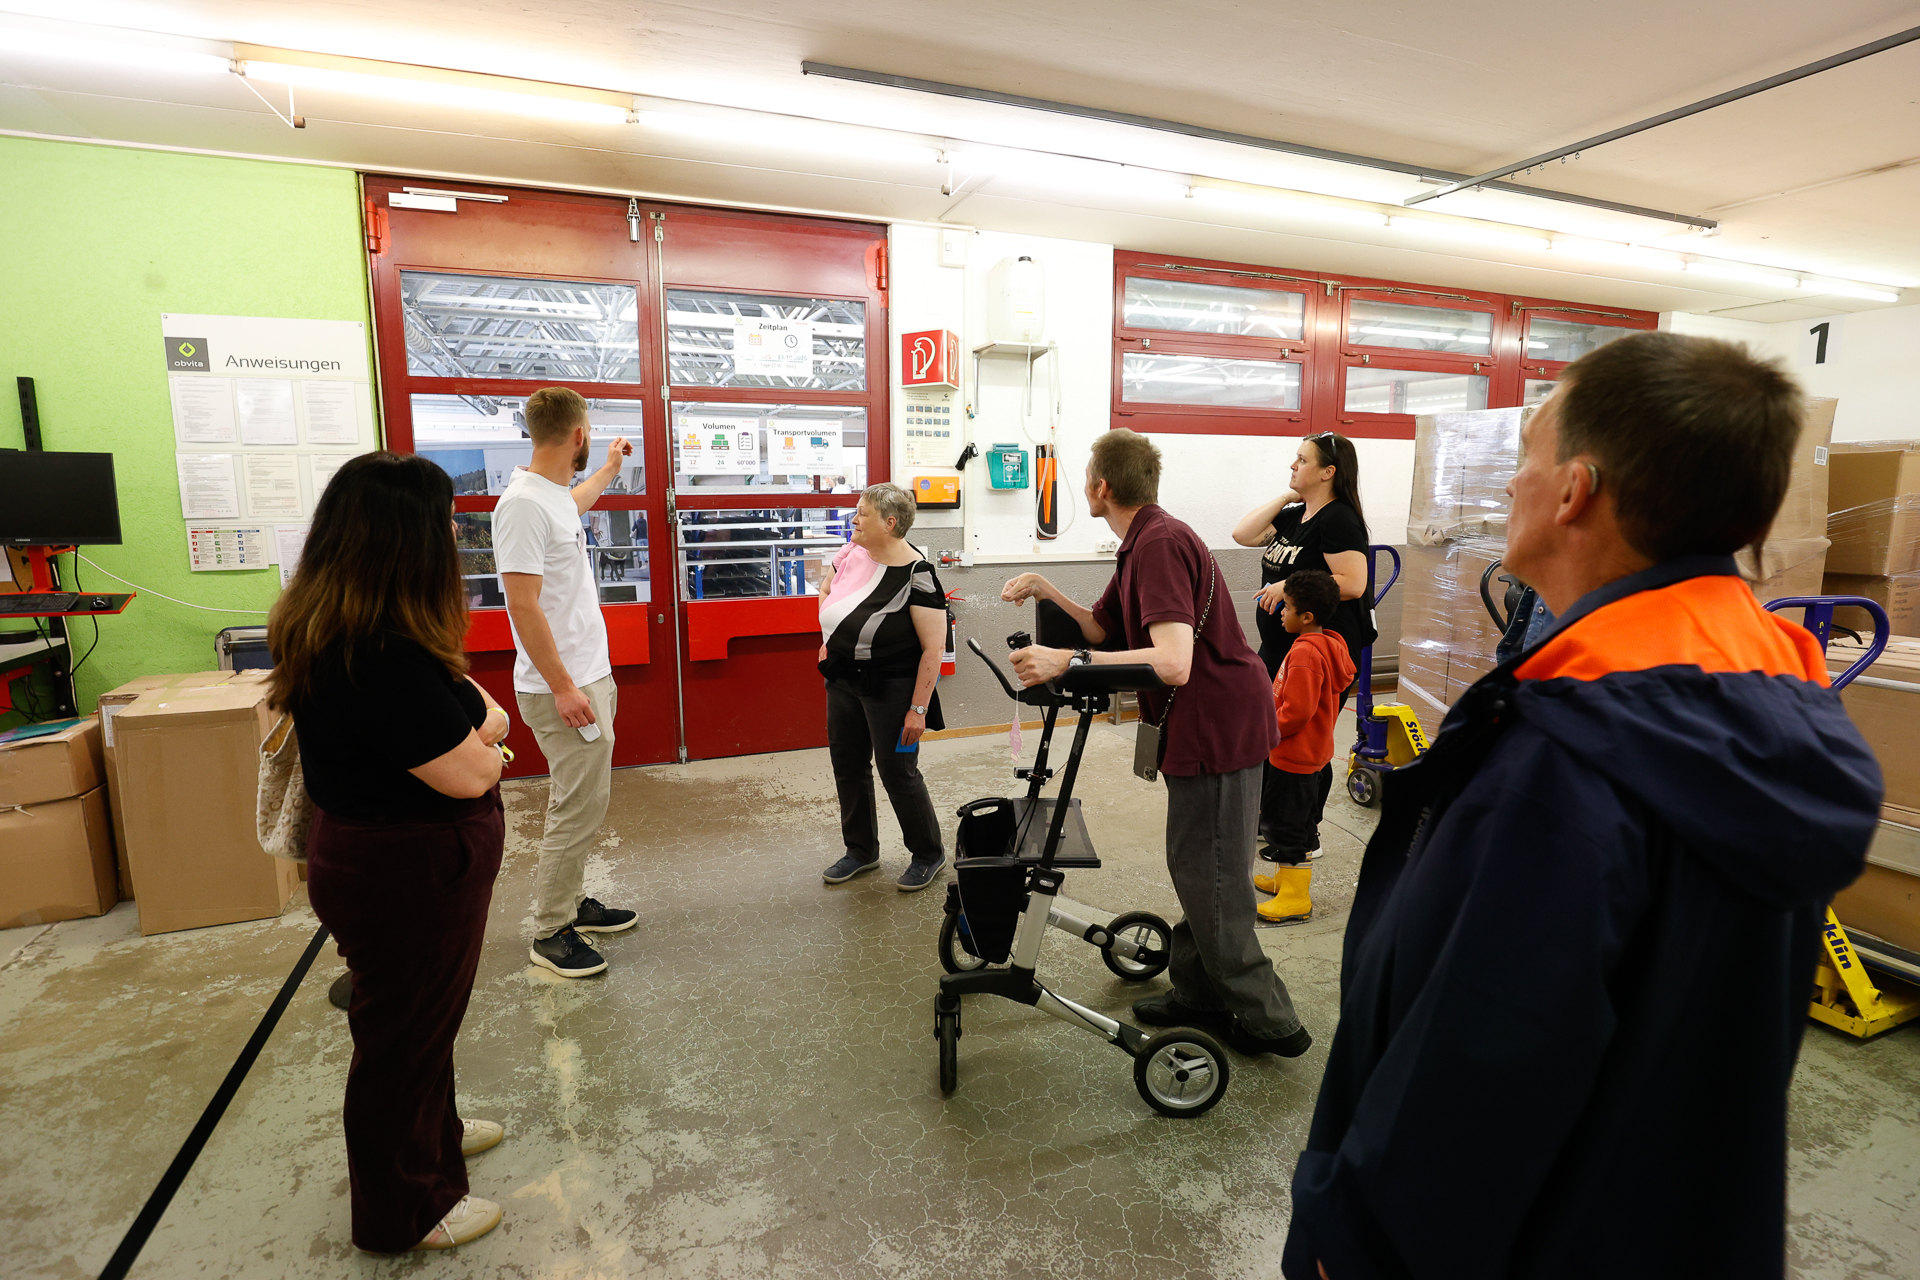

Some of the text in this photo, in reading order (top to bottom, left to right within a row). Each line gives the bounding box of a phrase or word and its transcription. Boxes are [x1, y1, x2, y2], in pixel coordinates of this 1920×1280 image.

[759, 323, 788, 331] Zeitplan
[1810, 322, 1829, 364] 1
[225, 354, 341, 373] Anweisungen
[773, 429, 837, 437] Transportvolumen
